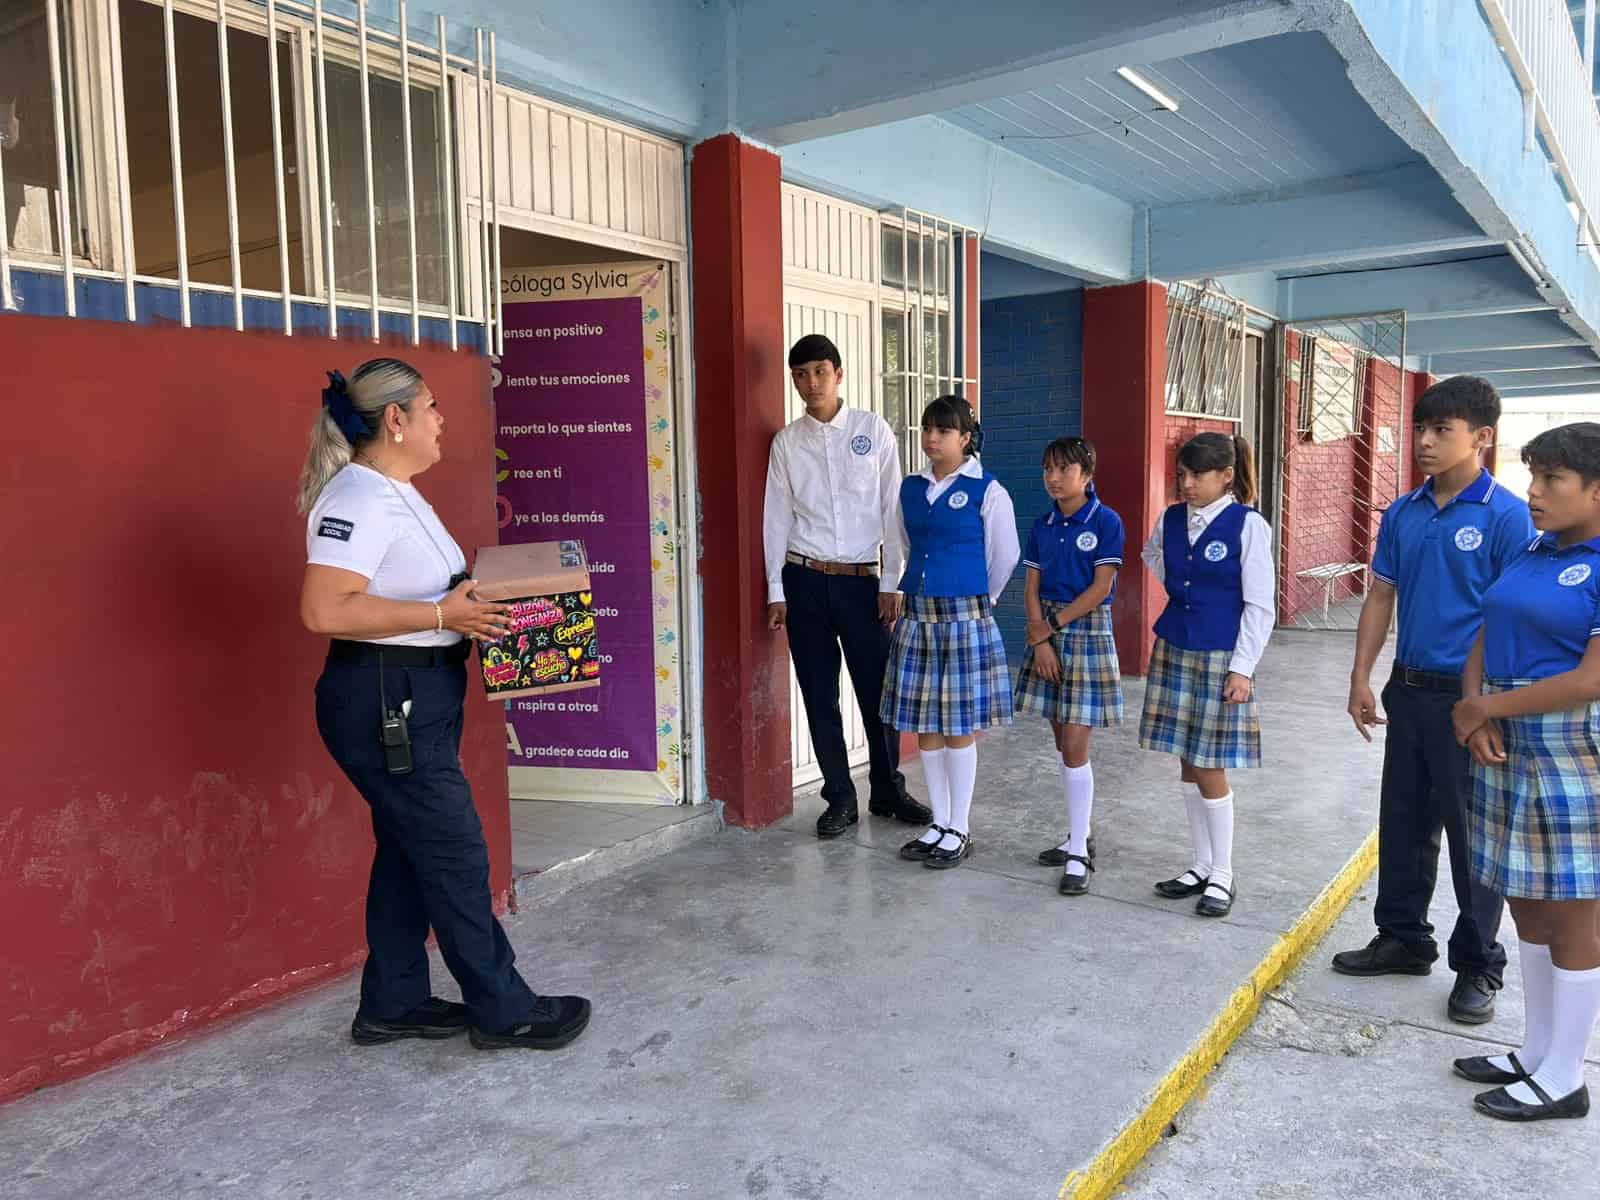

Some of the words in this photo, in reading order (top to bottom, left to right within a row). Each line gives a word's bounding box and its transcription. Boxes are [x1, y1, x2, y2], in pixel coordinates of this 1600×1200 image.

[500, 275, 565, 297] cóloga
[572, 270, 628, 295] Sylvia
[503, 329, 533, 339] ensa
[535, 328, 551, 338] en
[553, 323, 604, 340] positivo
[540, 375, 560, 386] tus
[561, 372, 631, 385] emociones
[547, 422, 559, 434] lo
[561, 424, 585, 437] que
[587, 420, 633, 434] sientes
[536, 469, 552, 478] en
[553, 466, 562, 478] ti
[531, 513, 540, 523] a
[541, 510, 560, 523] los
[562, 510, 605, 523] demás
[588, 561, 616, 573] uida
[557, 702, 567, 711] a
[568, 702, 599, 713] otros
[576, 748, 608, 758] cada
